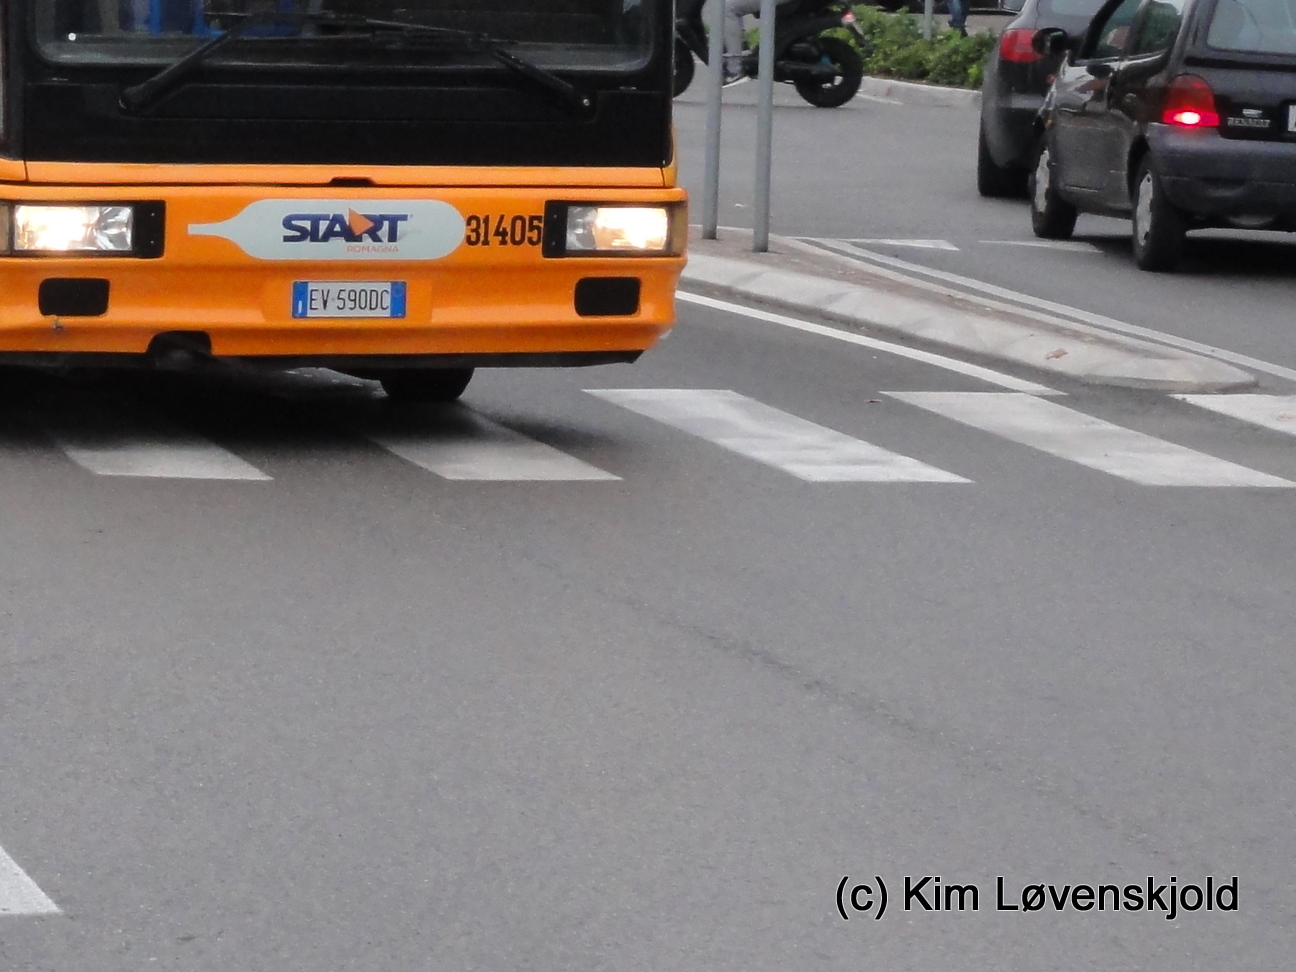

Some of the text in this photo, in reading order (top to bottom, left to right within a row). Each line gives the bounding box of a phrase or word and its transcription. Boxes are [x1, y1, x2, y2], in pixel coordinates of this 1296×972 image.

[282, 213, 408, 243] START
[466, 215, 543, 246] 31405
[346, 245, 400, 253] ROMAGNA
